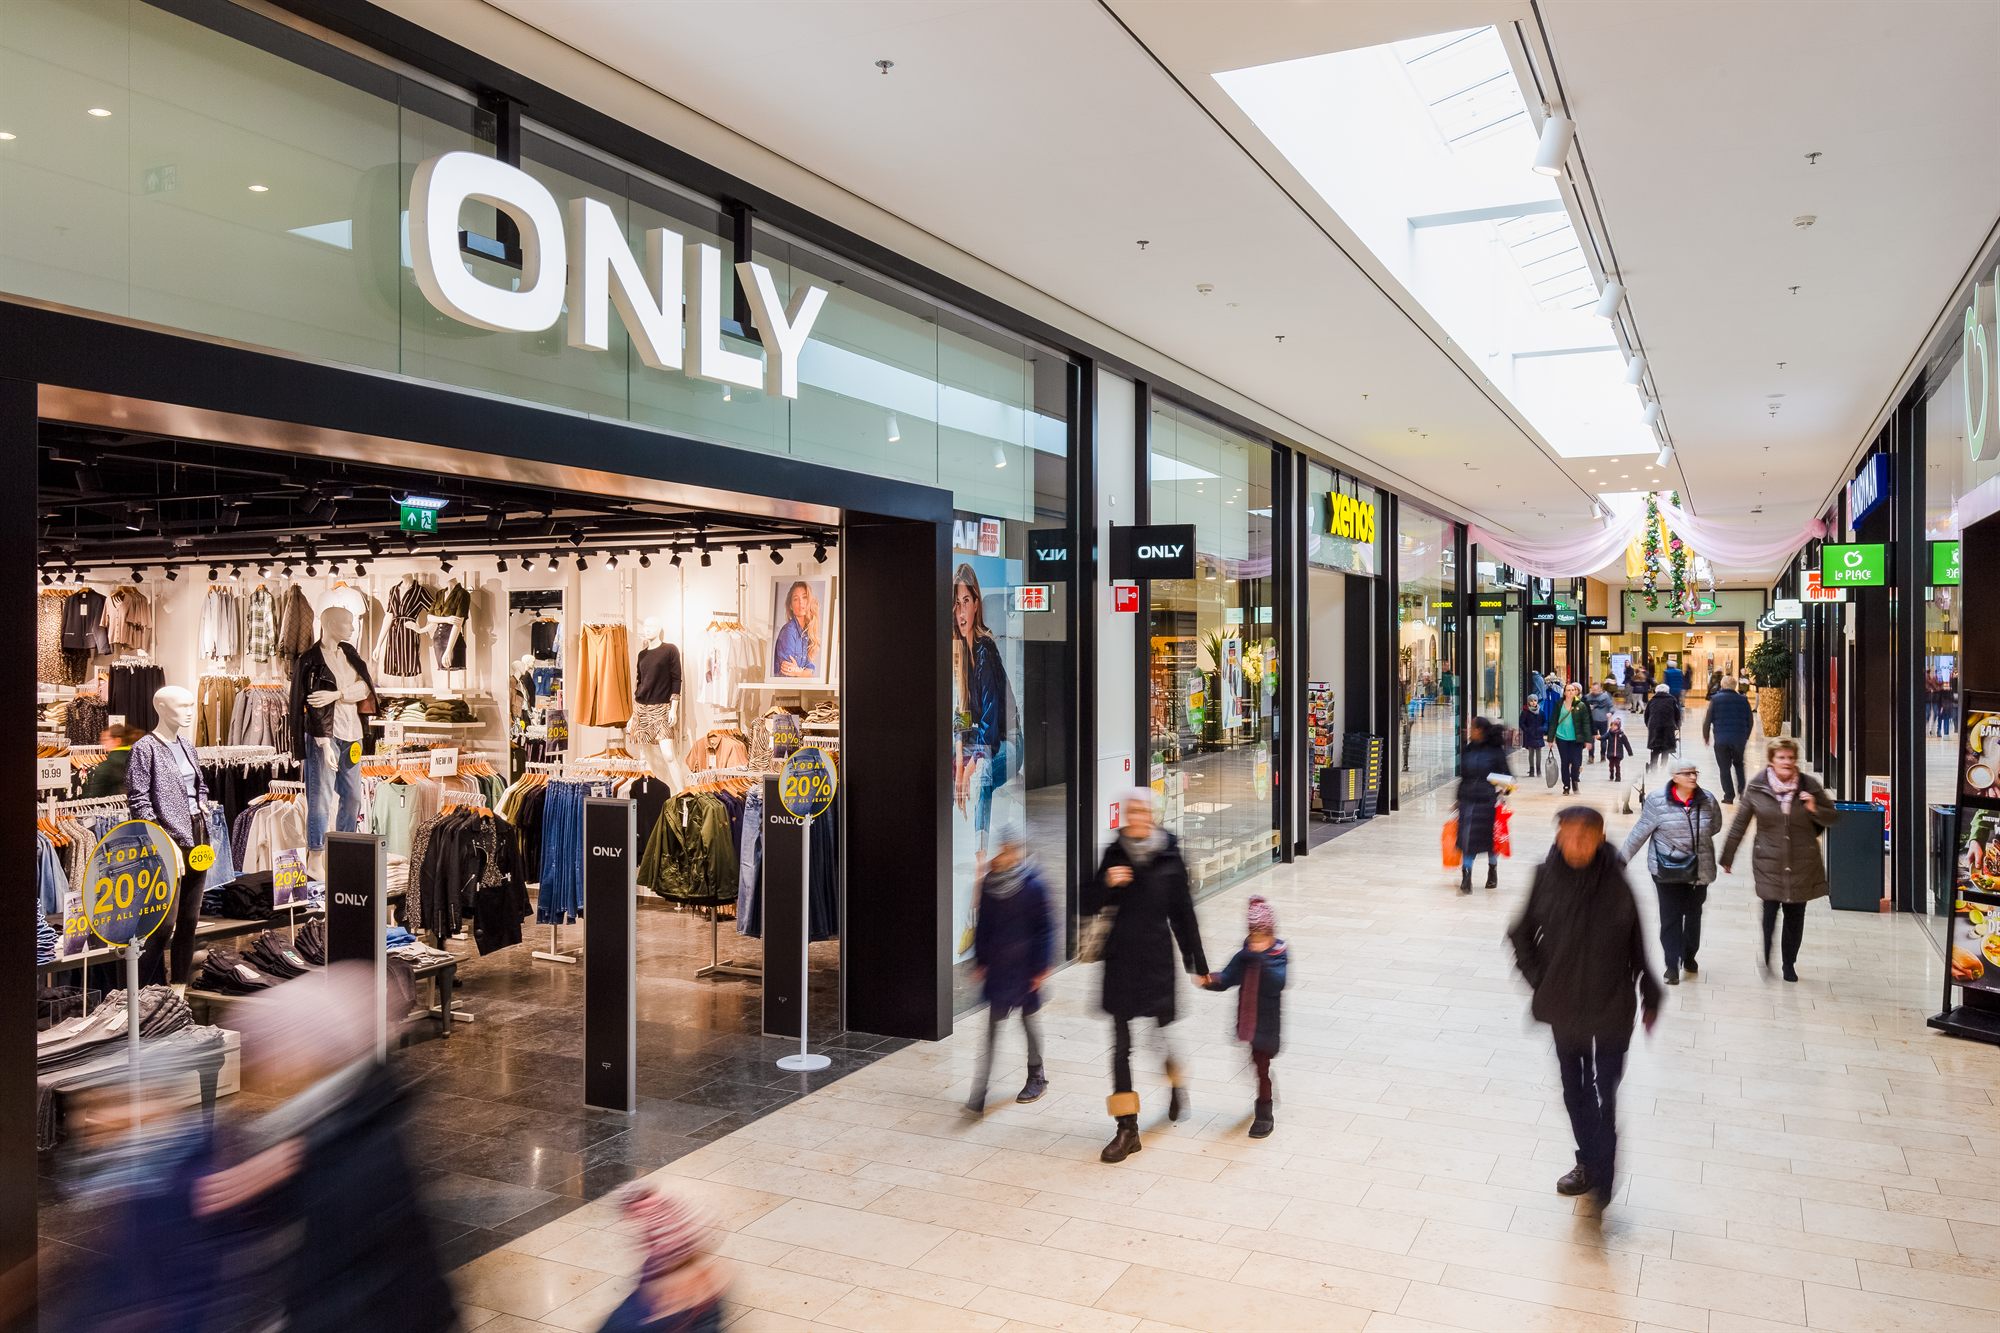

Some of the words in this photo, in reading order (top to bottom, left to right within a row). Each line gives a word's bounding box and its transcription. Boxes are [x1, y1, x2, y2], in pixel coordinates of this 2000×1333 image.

[410, 150, 829, 400] ONLY
[1329, 491, 1375, 544] xenos
[1137, 544, 1184, 559] ONLY
[1845, 569, 1872, 581] PLACE
[548, 726, 568, 738] 20%
[773, 732, 799, 744] 20%
[435, 757, 446, 766] NEW
[793, 761, 826, 770] TODAY
[41, 768, 62, 779] 19.99
[785, 775, 831, 797] 20%
[770, 815, 797, 825] ONLY
[105, 845, 159, 865] TODAY
[191, 853, 213, 864] 20%
[592, 846, 622, 858] ONLY
[274, 869, 307, 887] 20%
[93, 866, 168, 915] 20%
[335, 892, 368, 907] ONLY
[93, 916, 112, 926] OFF
[116, 911, 134, 921] ALL
[138, 902, 168, 916] JEANS
[65, 915, 89, 935] 20
